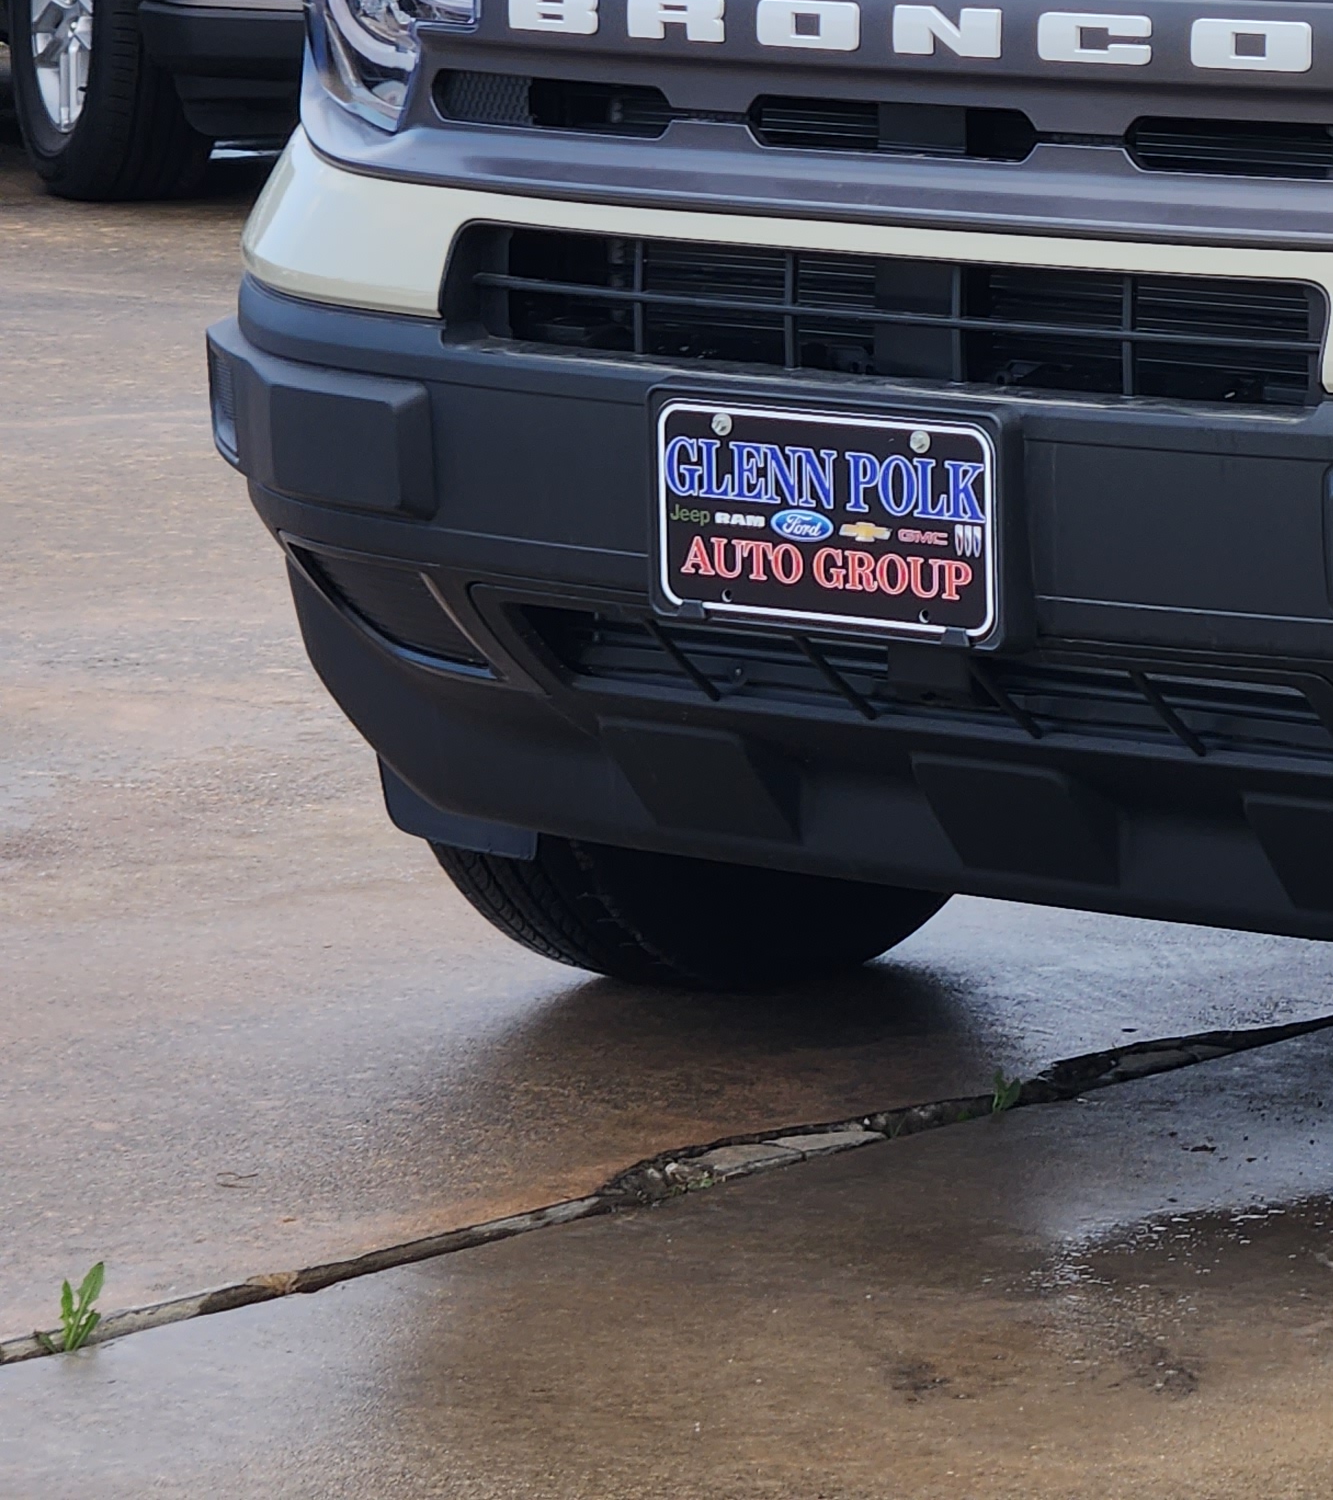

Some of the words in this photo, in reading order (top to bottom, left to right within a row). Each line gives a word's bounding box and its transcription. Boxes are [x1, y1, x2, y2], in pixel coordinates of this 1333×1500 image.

[666, 436, 837, 509] GLENN
[845, 451, 985, 523] POLK
[670, 504, 710, 526] Jeep
[715, 512, 766, 528] RAM
[782, 514, 822, 536] Ford
[898, 528, 948, 545] GMC
[680, 535, 804, 584] AUTO
[813, 548, 973, 601] GROUP
